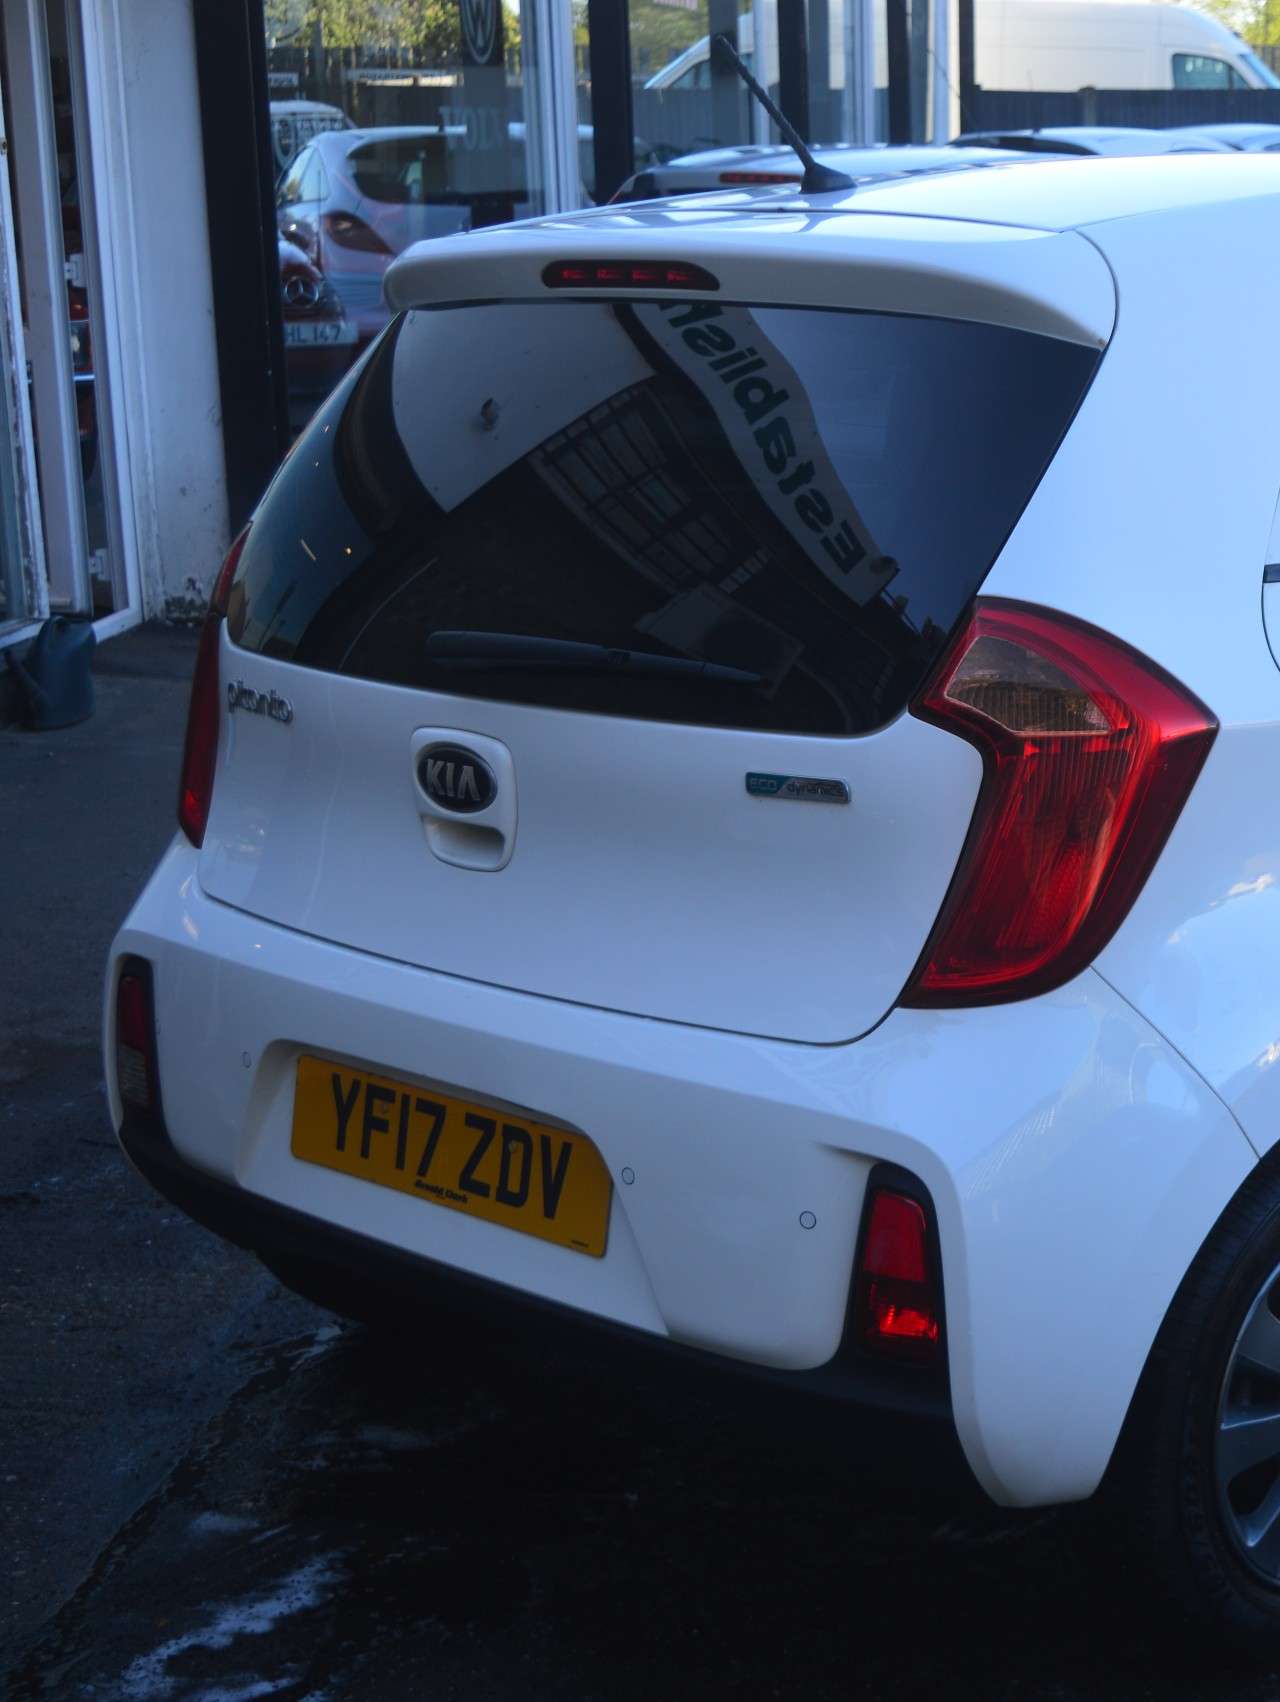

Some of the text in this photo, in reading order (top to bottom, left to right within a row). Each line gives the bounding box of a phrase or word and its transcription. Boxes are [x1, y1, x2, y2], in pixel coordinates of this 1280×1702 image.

[426, 758, 481, 801] KIA
[331, 1072, 573, 1221] YF17 ZDV
